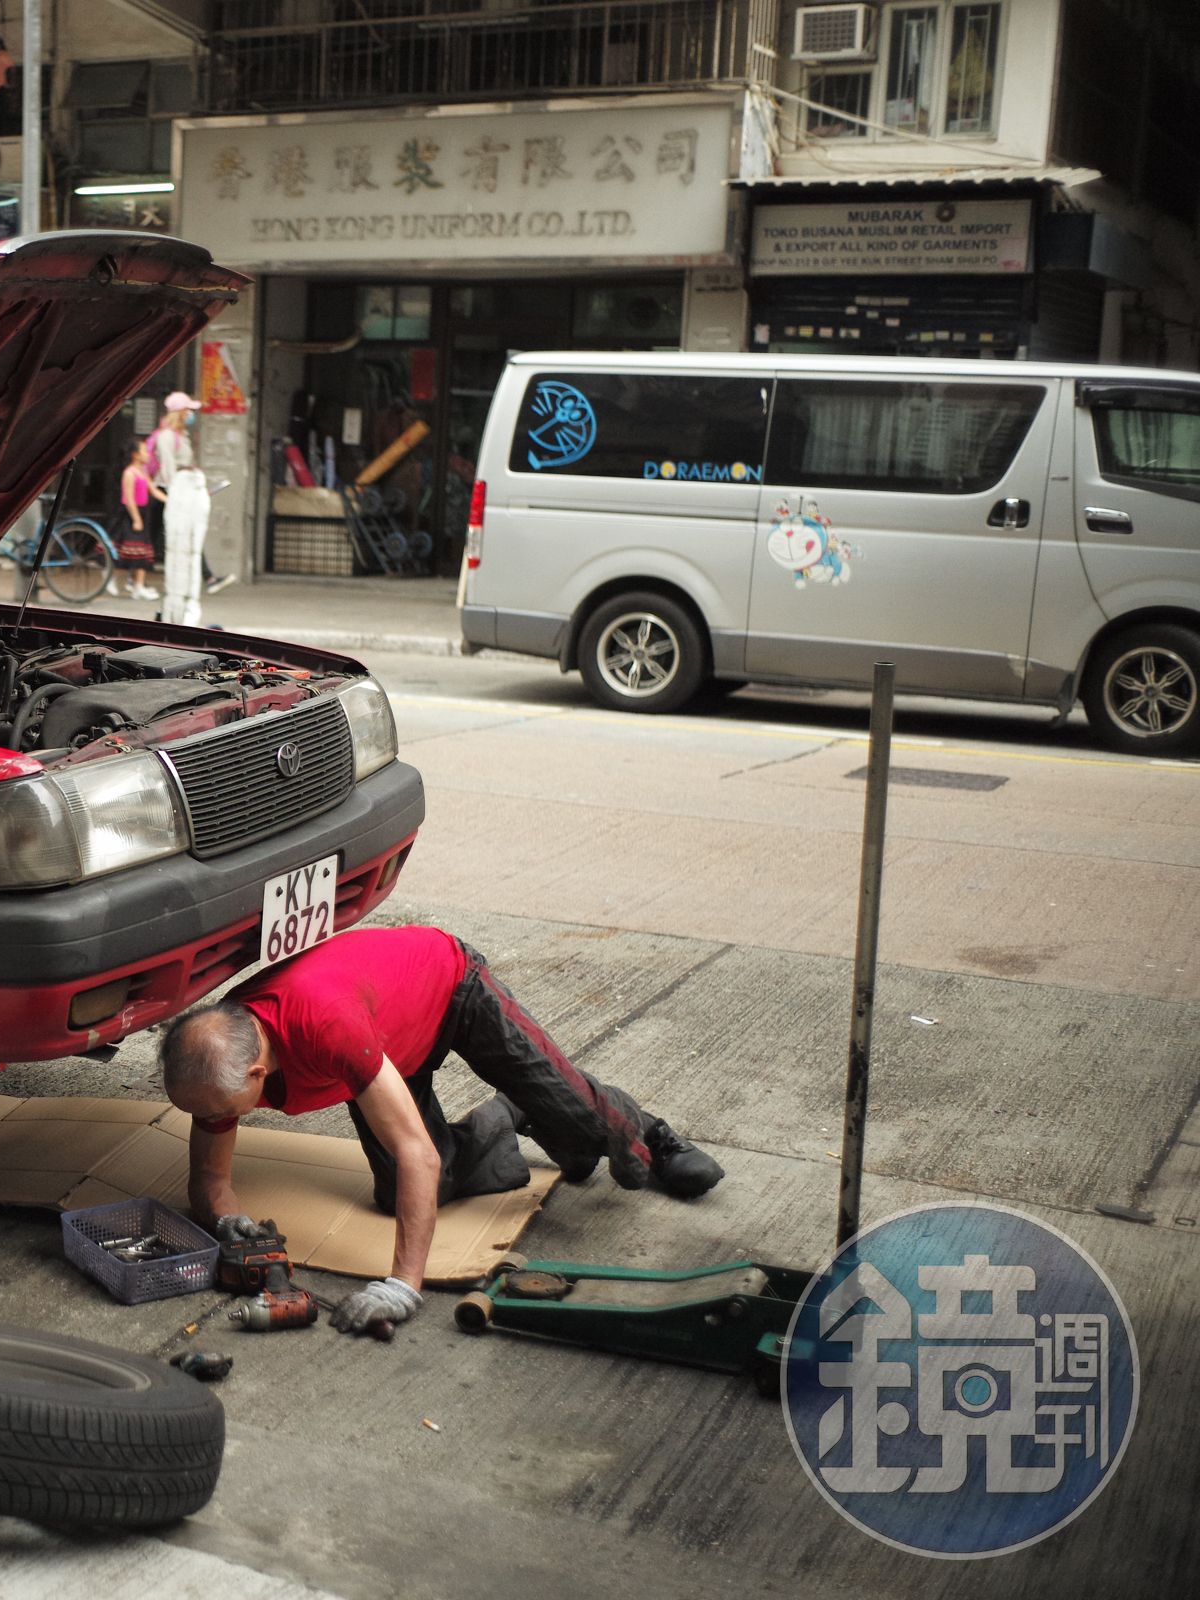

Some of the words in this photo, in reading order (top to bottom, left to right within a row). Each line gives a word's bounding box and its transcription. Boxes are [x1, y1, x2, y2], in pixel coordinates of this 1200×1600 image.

[251, 217, 319, 242] HONG
[325, 215, 394, 241] KONG
[401, 212, 522, 240] UNIFORM
[848, 210, 923, 223] MUBARAK
[764, 228, 798, 238] TOKO
[801, 226, 854, 237] BUSANA
[858, 225, 907, 236] MUSLIM
[911, 225, 956, 235] RETAIL
[960, 223, 1013, 235] IMPORT
[785, 241, 836, 252] EXPORT
[839, 242, 863, 251] ALL
[867, 241, 898, 251] KIND
[902, 240, 919, 250] OF
[923, 239, 998, 250] GARMENTS
[643, 460, 763, 482] DORAEMON
[284, 864, 317, 915] KY
[267, 900, 329, 962] 6872
